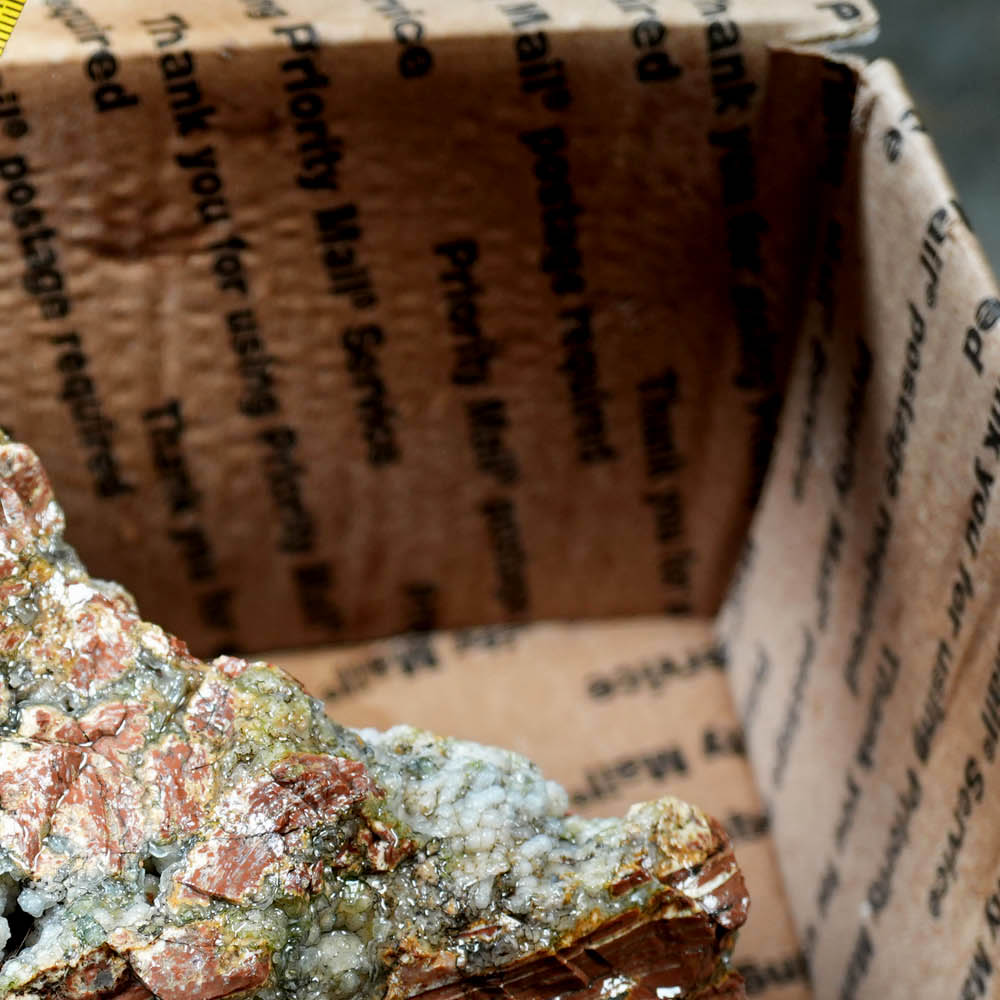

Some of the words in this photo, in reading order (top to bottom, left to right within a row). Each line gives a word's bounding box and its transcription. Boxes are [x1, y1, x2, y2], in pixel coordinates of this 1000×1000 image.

[140, 14, 217, 138] Thank
[273, 24, 344, 192] Priority
[173, 145, 230, 225] you
[225, 309, 278, 417] using
[886, 303, 926, 498] postage
[962, 455, 995, 559] you
[927, 757, 985, 919] Service
